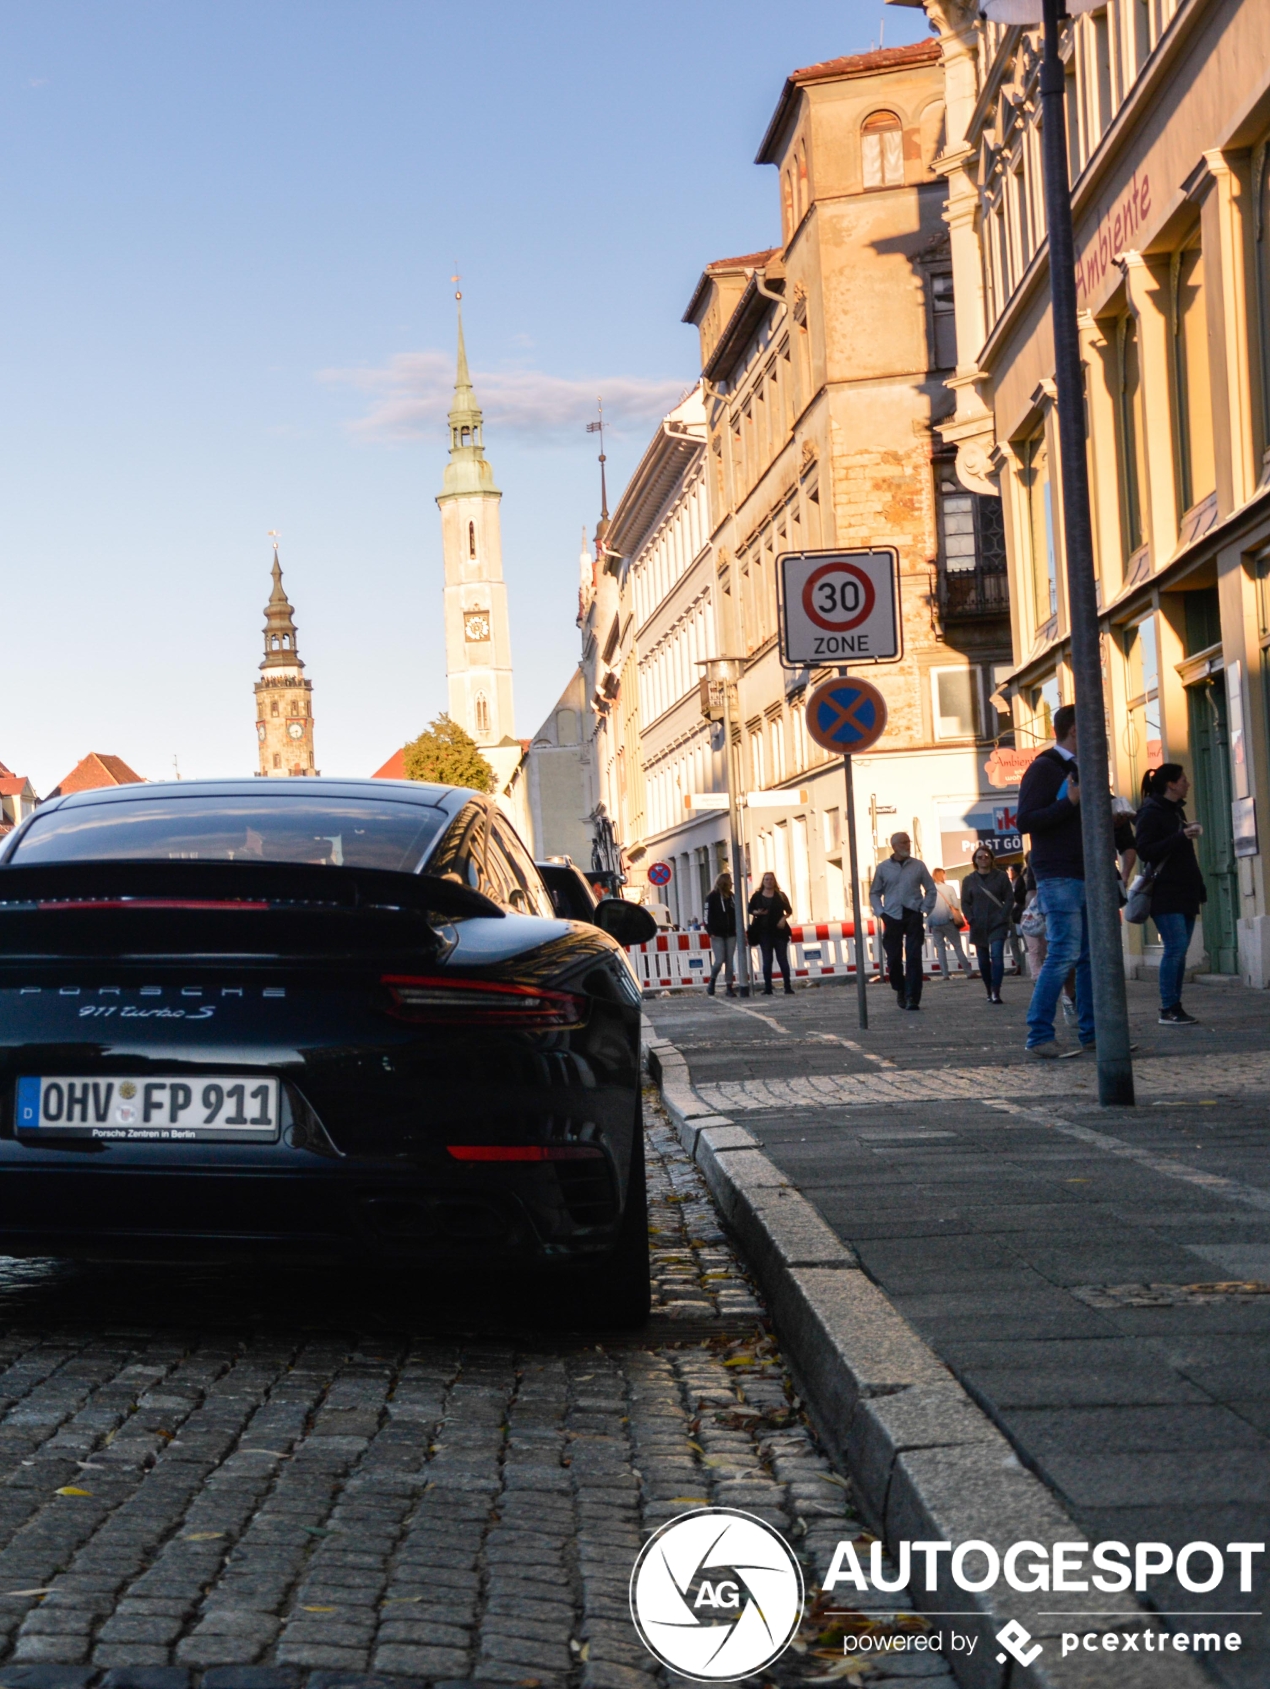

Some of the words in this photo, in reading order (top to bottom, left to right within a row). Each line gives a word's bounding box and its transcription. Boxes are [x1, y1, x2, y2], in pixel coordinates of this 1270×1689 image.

[1076, 171, 1152, 298] Ambiente
[818, 581, 859, 613] 30
[814, 635, 869, 654] ZONE
[993, 755, 1034, 769] Ambient
[1005, 774, 1022, 782] woh
[1003, 836, 1023, 850] GÖ
[20, 986, 286, 998] PORSCHE
[78, 1005, 117, 1017] 911
[186, 1005, 216, 1019] S
[42, 1082, 115, 1122] OHV
[143, 1083, 192, 1124] FP
[202, 1084, 272, 1126] 911
[23, 1107, 33, 1120] D
[92, 1128, 125, 1138] Porsche
[127, 1129, 159, 1138] Zentren
[161, 1129, 169, 1138] in
[171, 1129, 196, 1139] Berlin
